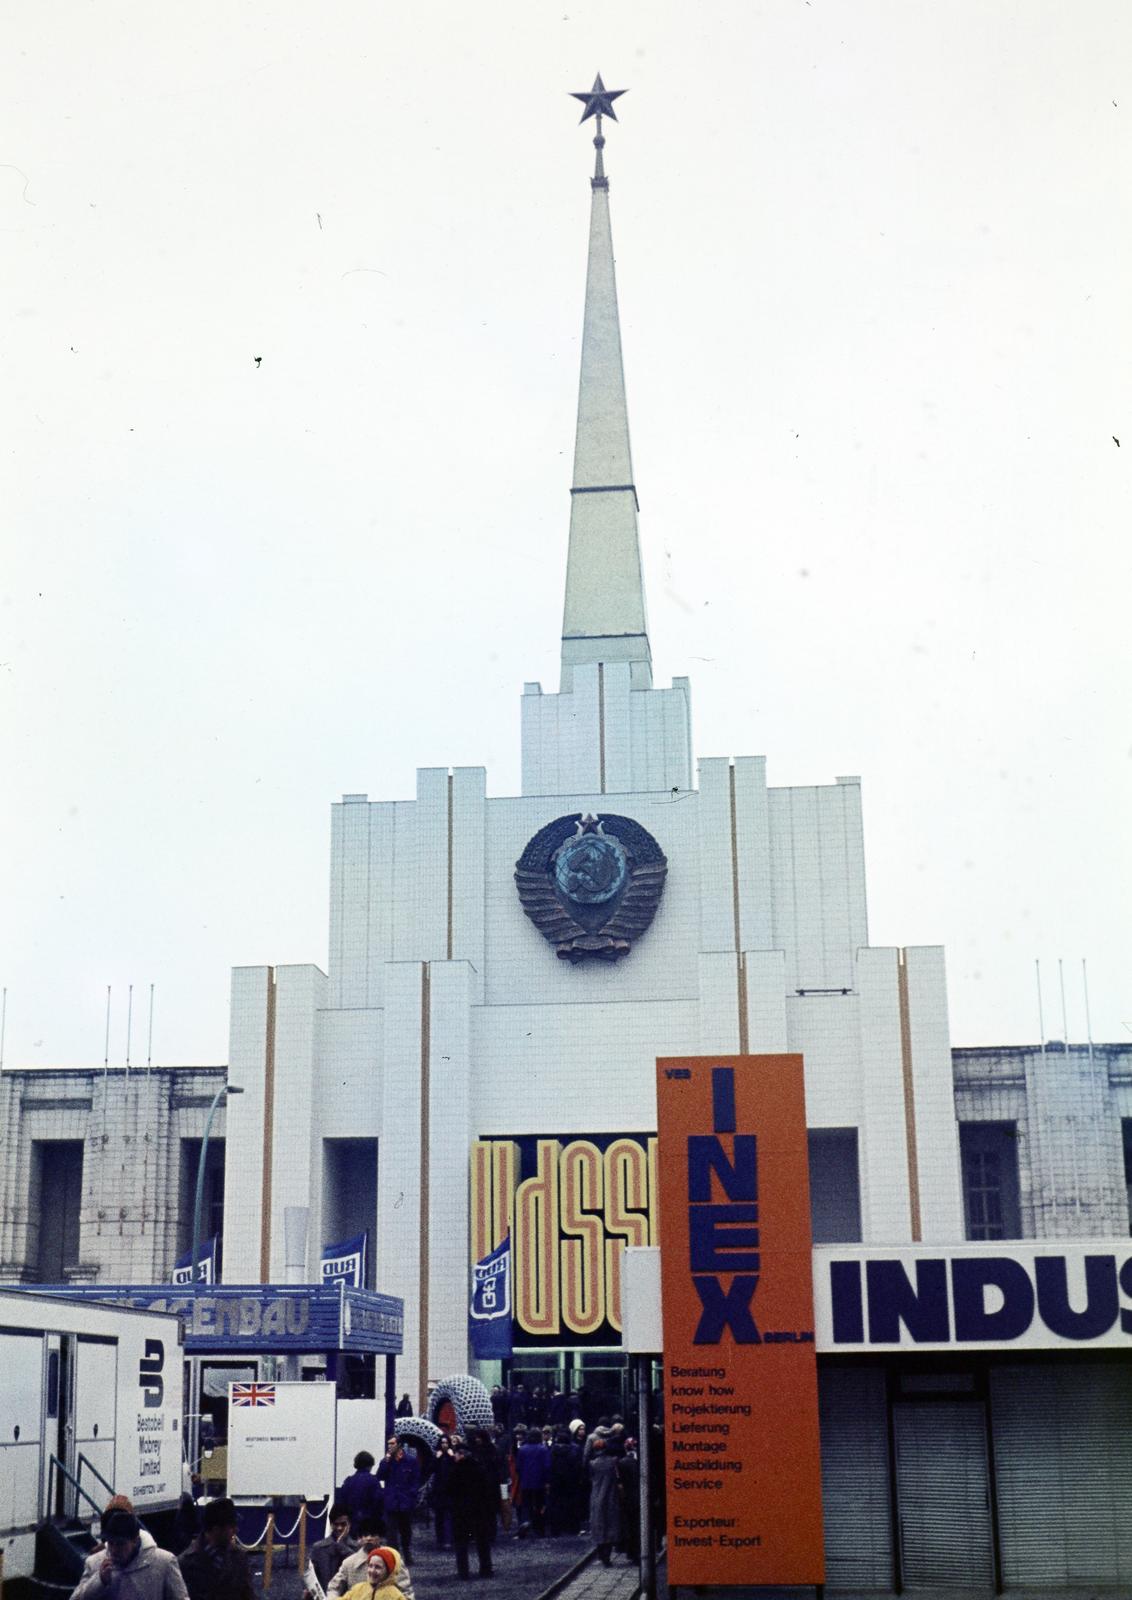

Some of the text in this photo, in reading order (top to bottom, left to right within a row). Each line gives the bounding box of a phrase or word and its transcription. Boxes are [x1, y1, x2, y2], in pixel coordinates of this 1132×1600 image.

[687, 1067, 762, 1344] INEX
[829, 1254, 1132, 1344] INDU
[763, 1331, 814, 1343] BERLIN
[670, 1366, 726, 1379] Beratung
[671, 1385, 735, 1396] know how
[672, 1403, 752, 1416] Projektierung
[672, 1422, 730, 1435] Lieferung
[672, 1441, 727, 1453] Montage
[139, 1457, 161, 1477] Limited
[673, 1460, 742, 1473] Ausbildung
[673, 1478, 723, 1489] Service
